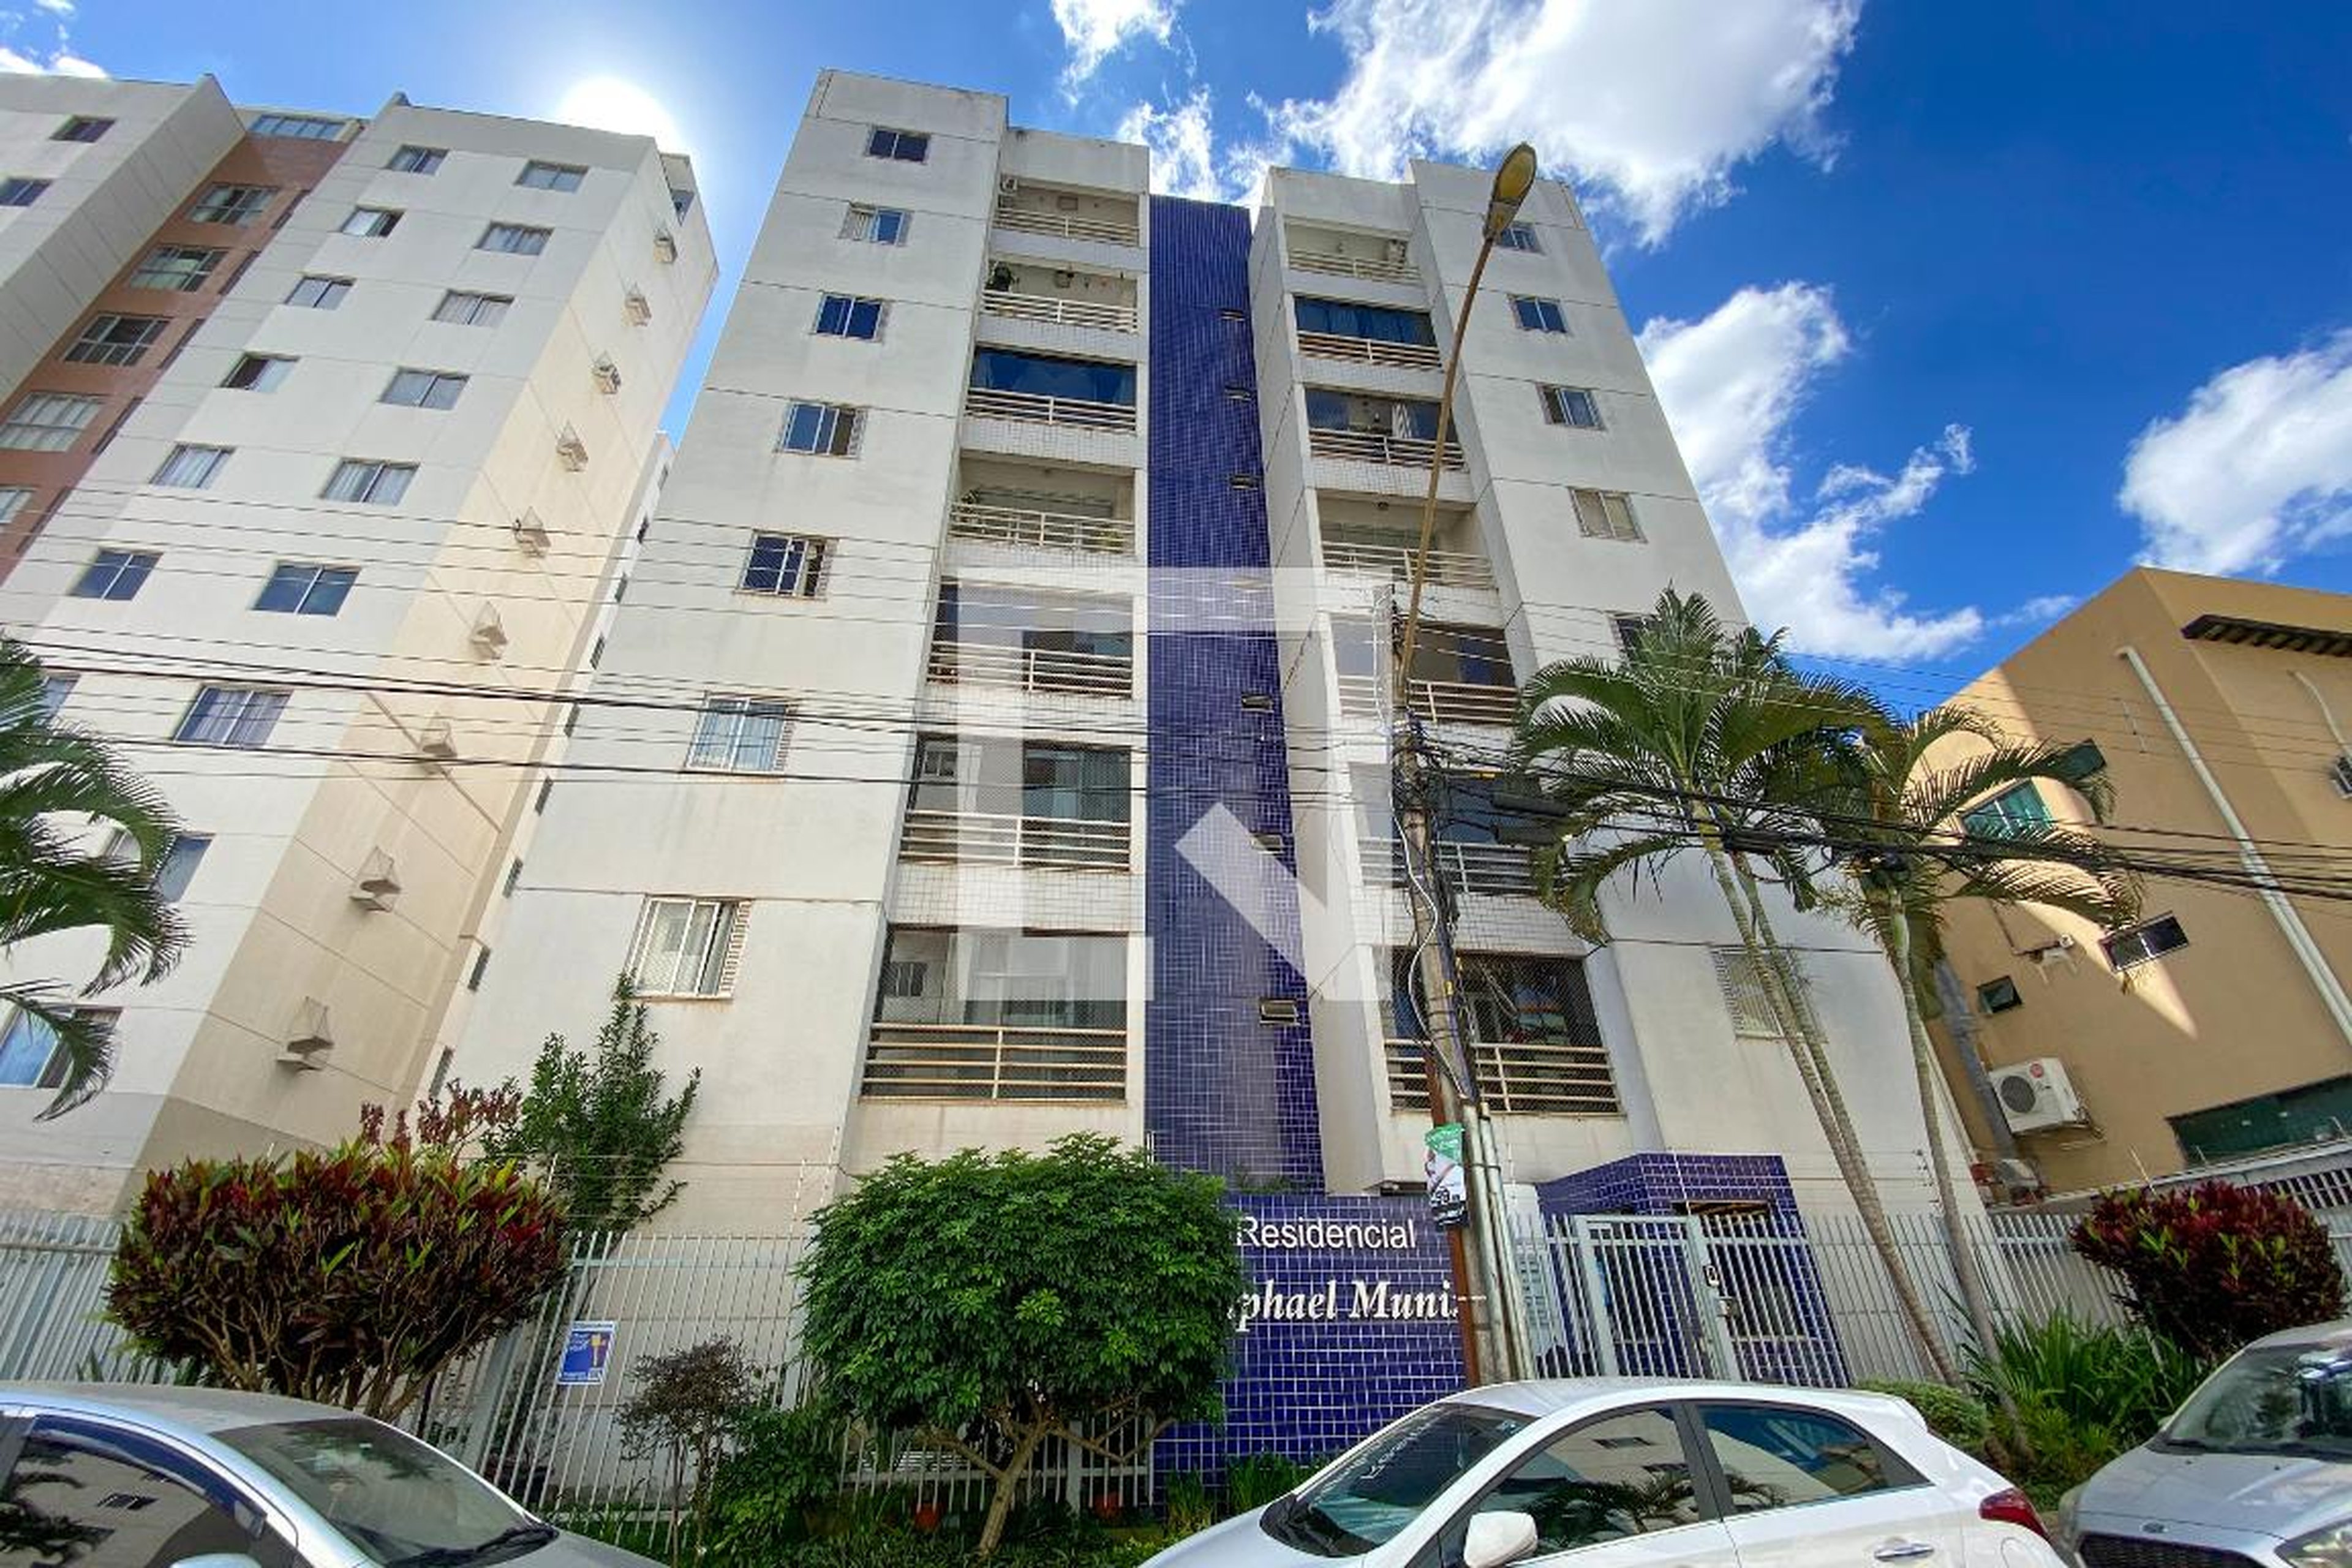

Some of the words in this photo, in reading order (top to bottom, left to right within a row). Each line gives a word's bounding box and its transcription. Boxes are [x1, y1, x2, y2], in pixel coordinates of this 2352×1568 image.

[1237, 1216, 1416, 1248] Residencial
[1226, 1278, 1337, 1332] phael
[1349, 1279, 1459, 1319] Muni
